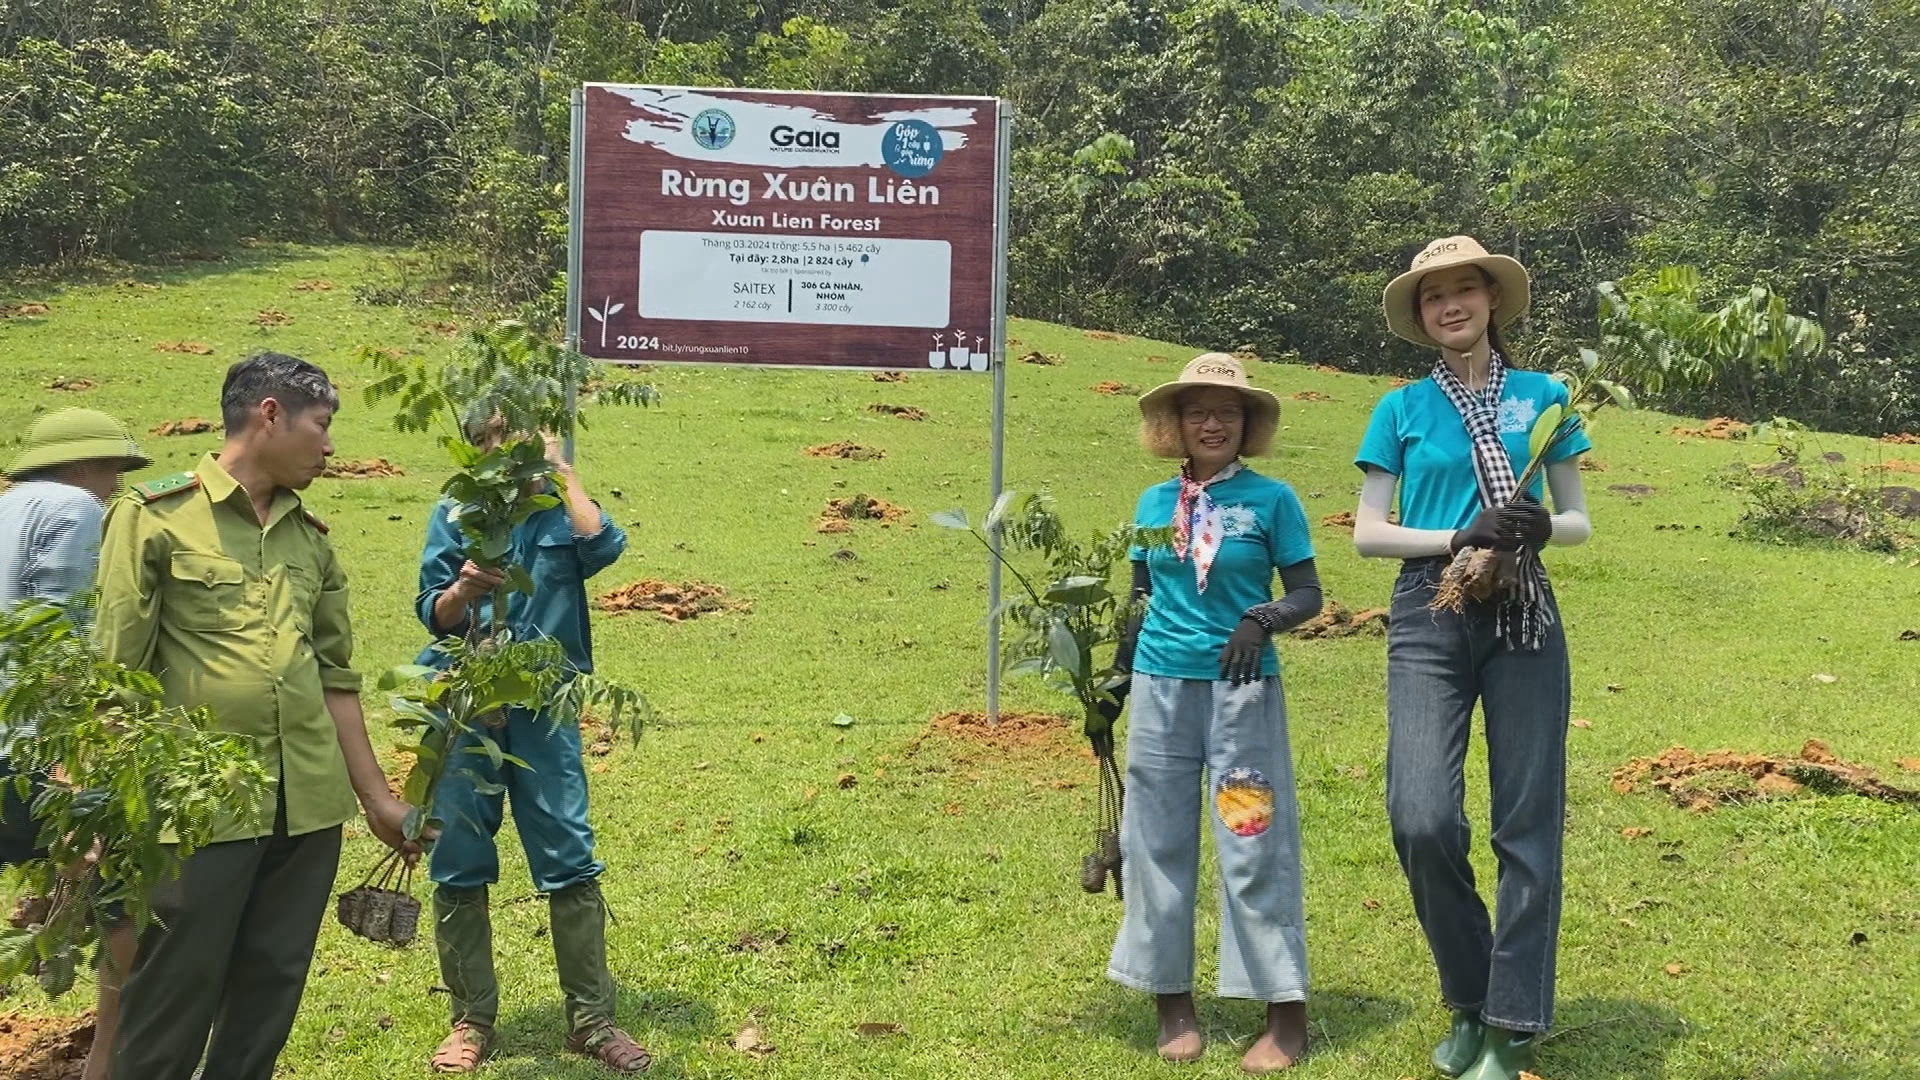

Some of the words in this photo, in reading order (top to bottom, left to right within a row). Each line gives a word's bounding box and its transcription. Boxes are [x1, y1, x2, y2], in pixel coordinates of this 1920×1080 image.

[770, 125, 840, 148] Gaia
[661, 169, 750, 205] Rừng
[762, 172, 854, 203] Xuân
[868, 176, 940, 205] Liên
[711, 209, 765, 228] Xuan
[772, 212, 813, 230] Lien
[820, 214, 881, 231] Forest
[733, 240, 770, 249] 03.2024
[818, 243, 831, 251] ha
[846, 244, 863, 252] 462
[865, 244, 881, 255] cây
[1419, 243, 1458, 264] Gaia
[729, 253, 745, 264] Tại
[747, 254, 769, 266] đây:
[771, 255, 799, 265] 2,8ha
[816, 256, 833, 265] 824
[836, 257, 854, 268] cây
[733, 282, 776, 295] SAITEX
[801, 281, 817, 289] 306
[734, 301, 740, 309] 2
[742, 301, 757, 309] 162
[822, 304, 838, 312] 300
[617, 335, 659, 350] 2024
[662, 343, 749, 355] bit.ly/rungxuanlien10
